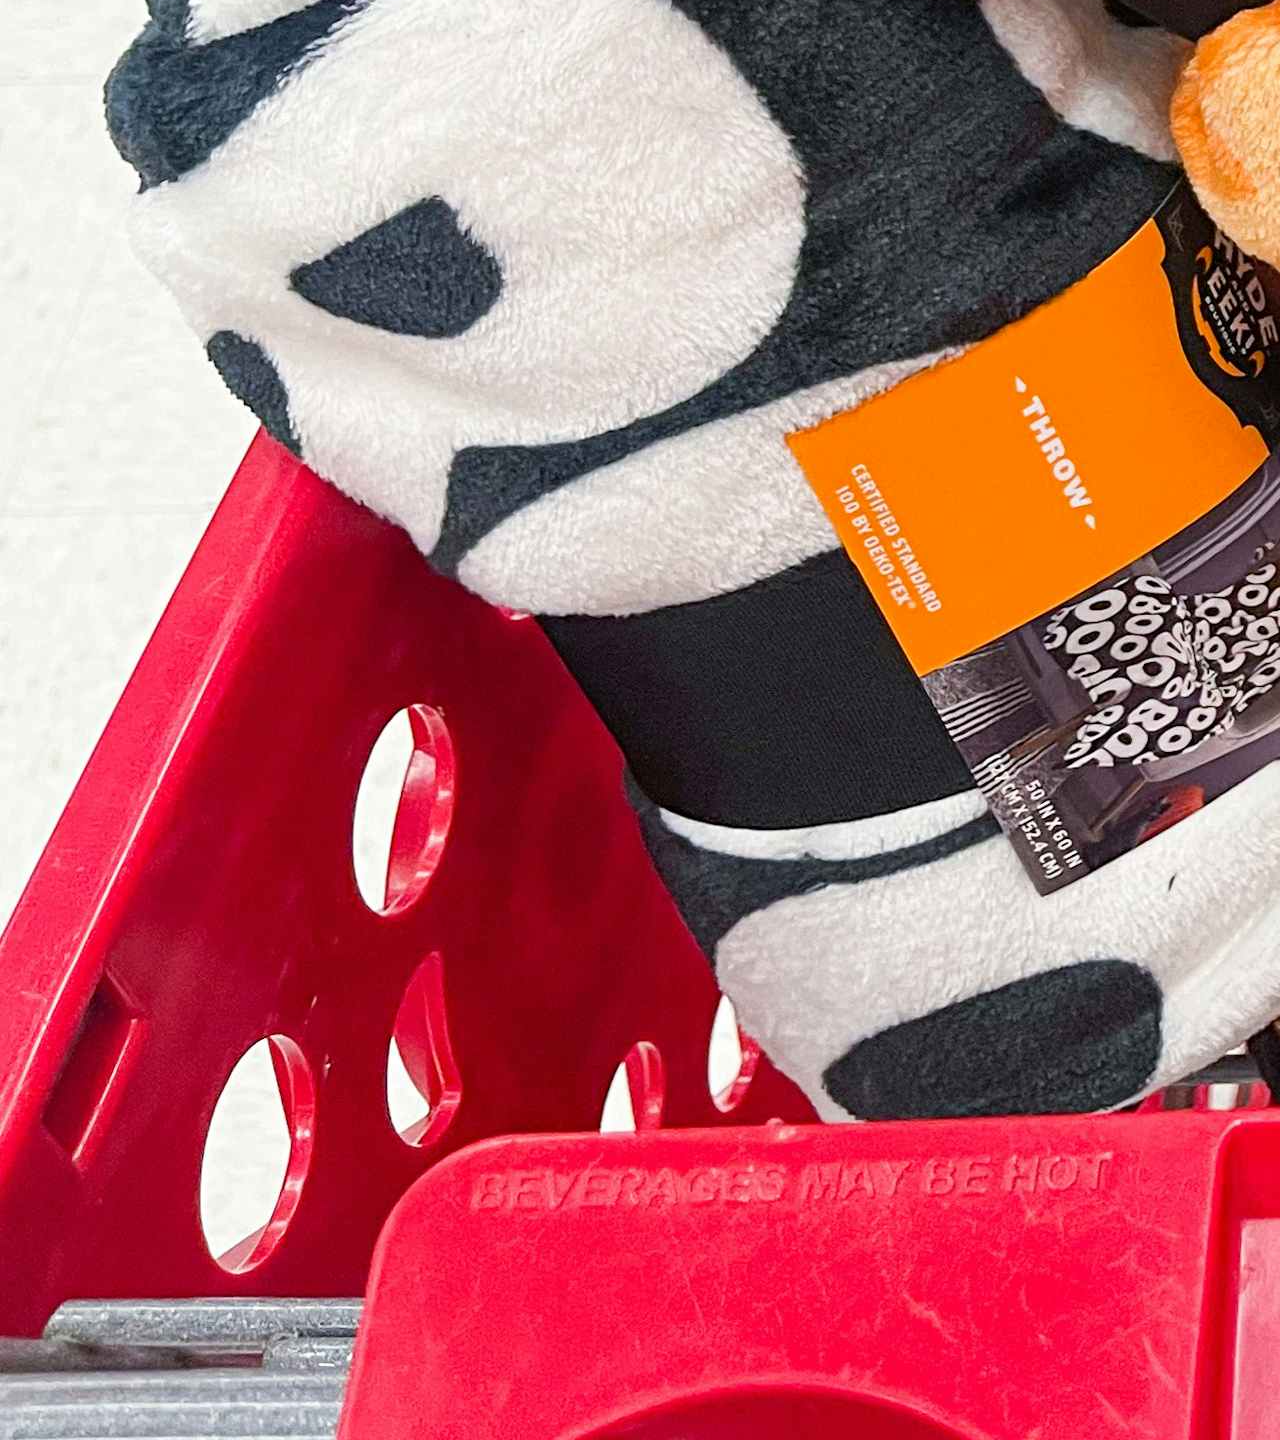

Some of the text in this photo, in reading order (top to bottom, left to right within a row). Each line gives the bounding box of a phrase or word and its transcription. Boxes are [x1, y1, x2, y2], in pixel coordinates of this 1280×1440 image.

[1207, 266, 1256, 355] EEK!
[1022, 395, 1093, 509] THROW
[835, 485, 860, 514] 100
[852, 514, 873, 535] BY
[851, 464, 942, 613] CERTIFIED STANDARD
[1001, 783, 1023, 805] CM
[1012, 804, 1029, 818] X
[1018, 816, 1048, 852] 152.4
[1025, 779, 1083, 869] 50 IN X 60 IN
[1039, 852, 1064, 879] CM)
[470, 1151, 1113, 1212] BEVERAGES MAY BE HOT
